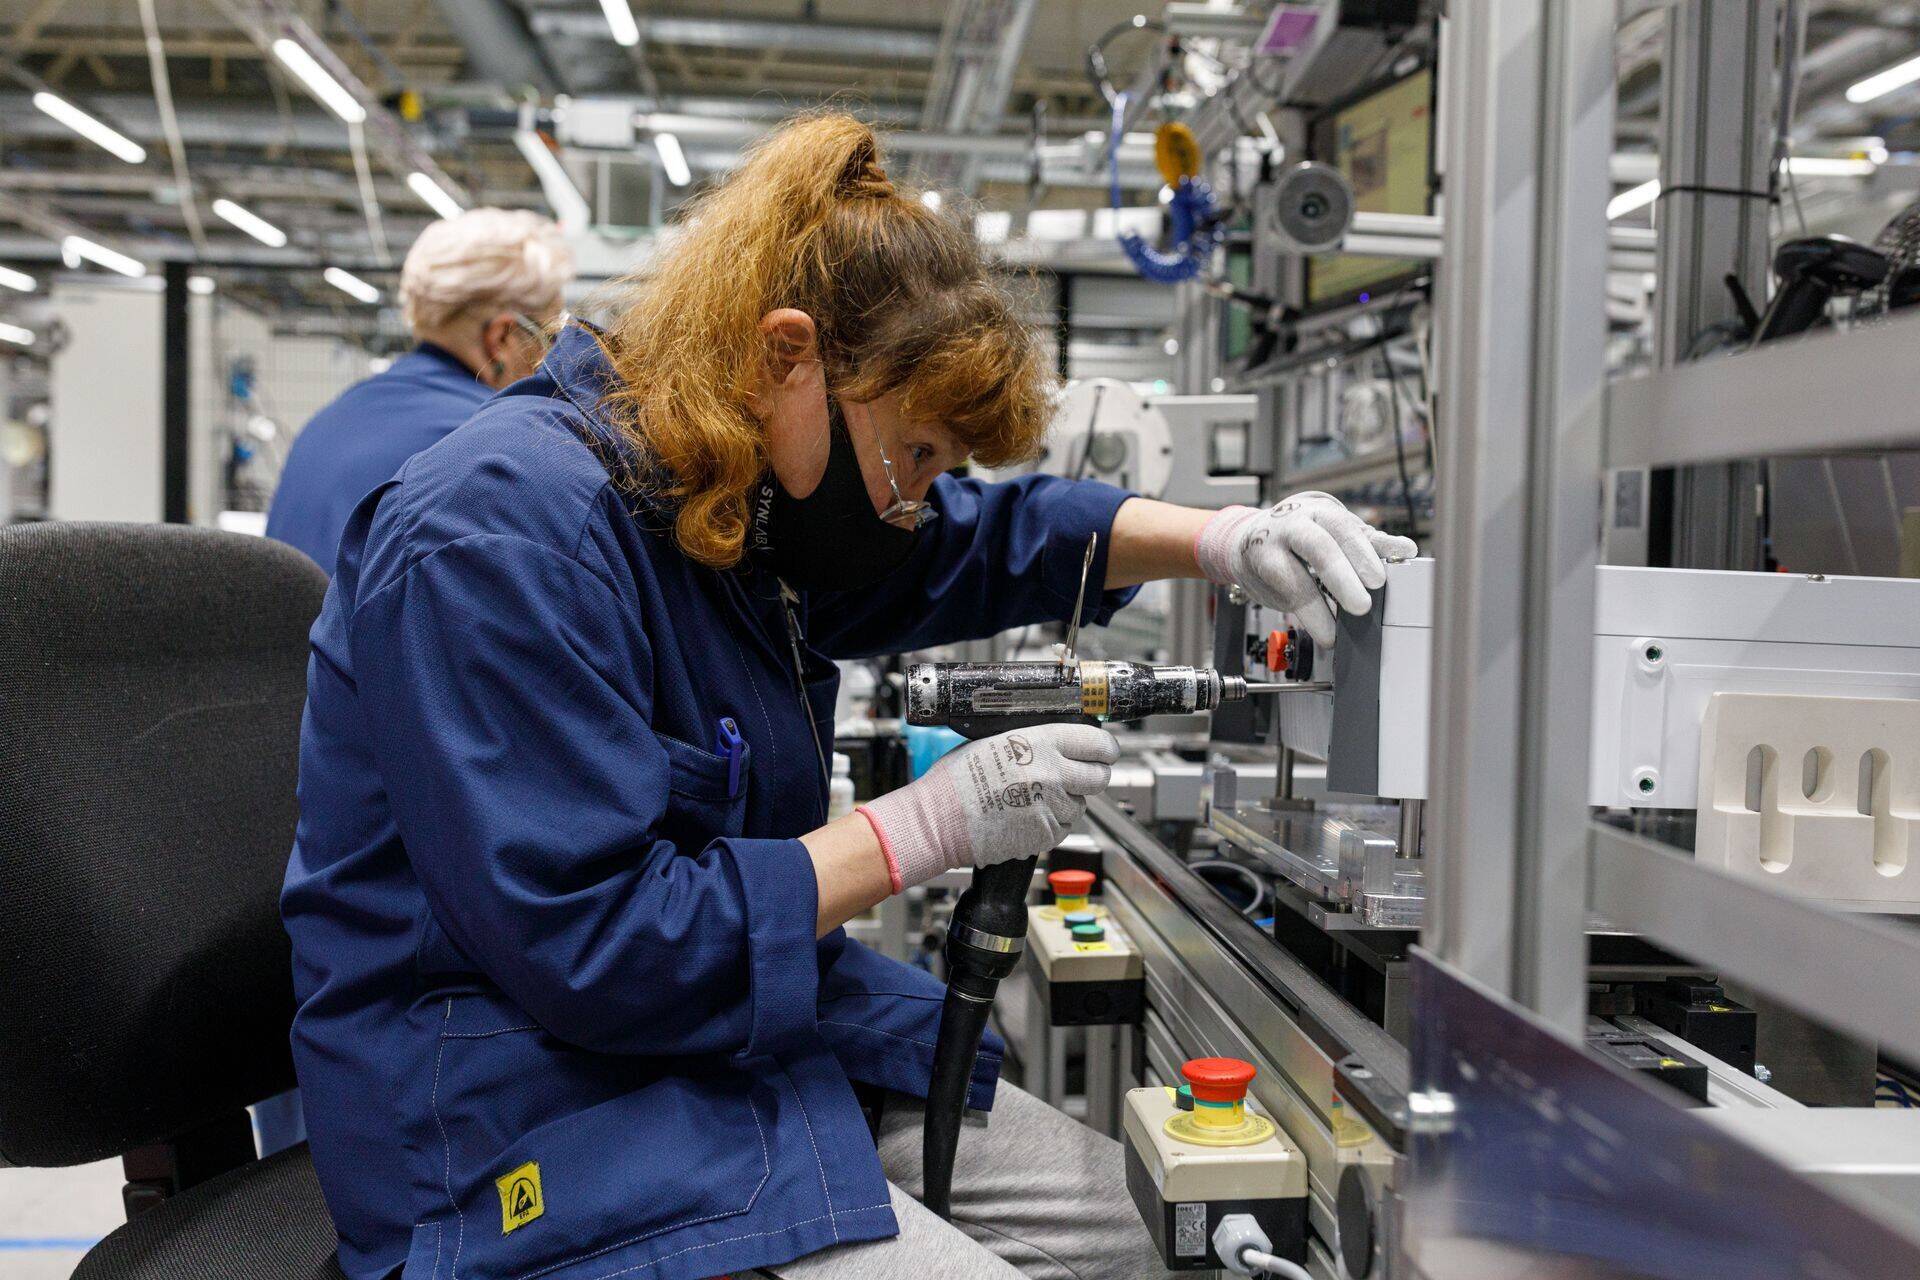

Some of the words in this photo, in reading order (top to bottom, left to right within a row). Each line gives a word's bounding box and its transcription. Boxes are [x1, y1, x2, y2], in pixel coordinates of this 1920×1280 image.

[755, 486, 774, 545] SYNLAB
[1003, 744, 1013, 762] EPA
[1031, 781, 1044, 802] CE
[1192, 1221, 1206, 1231] CE
